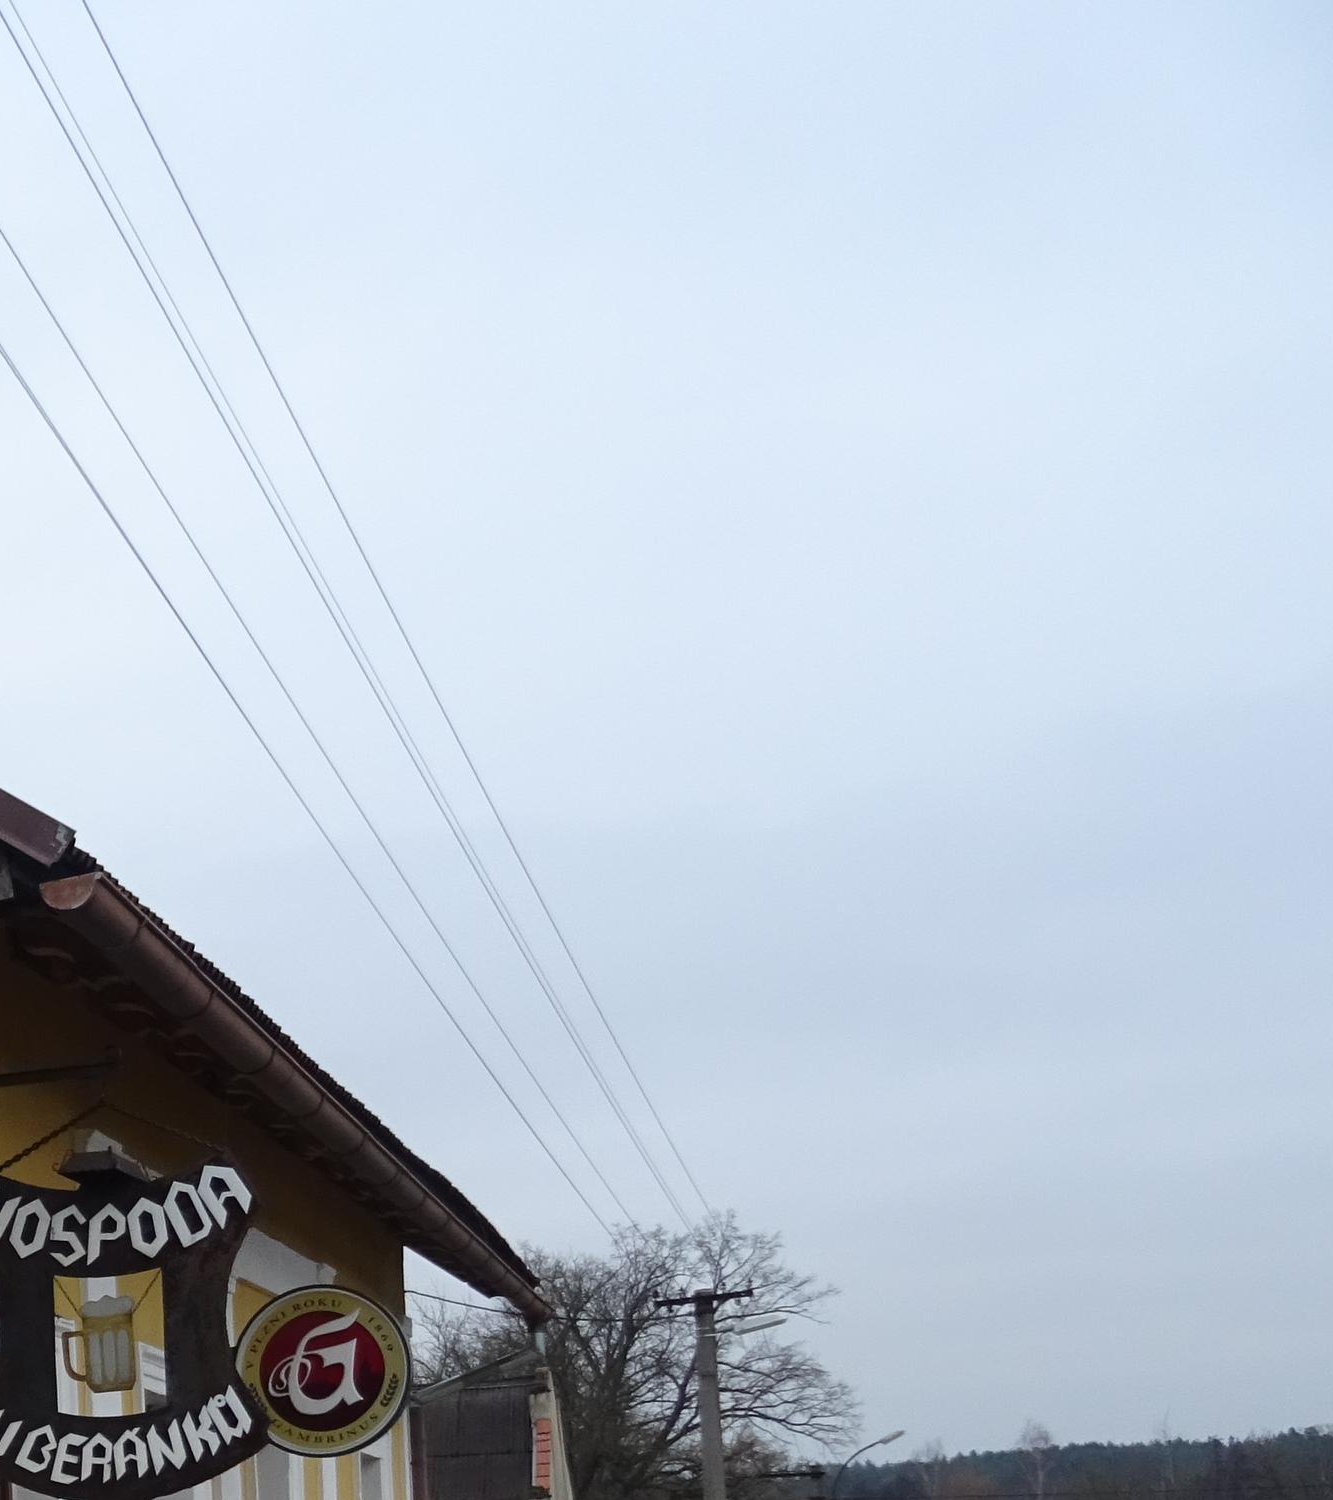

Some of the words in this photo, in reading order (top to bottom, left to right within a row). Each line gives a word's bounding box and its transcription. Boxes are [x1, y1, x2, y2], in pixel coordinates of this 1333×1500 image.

[292, 1298, 343, 1312] ROKU
[367, 1316, 394, 1352] 1869
[273, 1414, 379, 1444] GAMBRINUS
